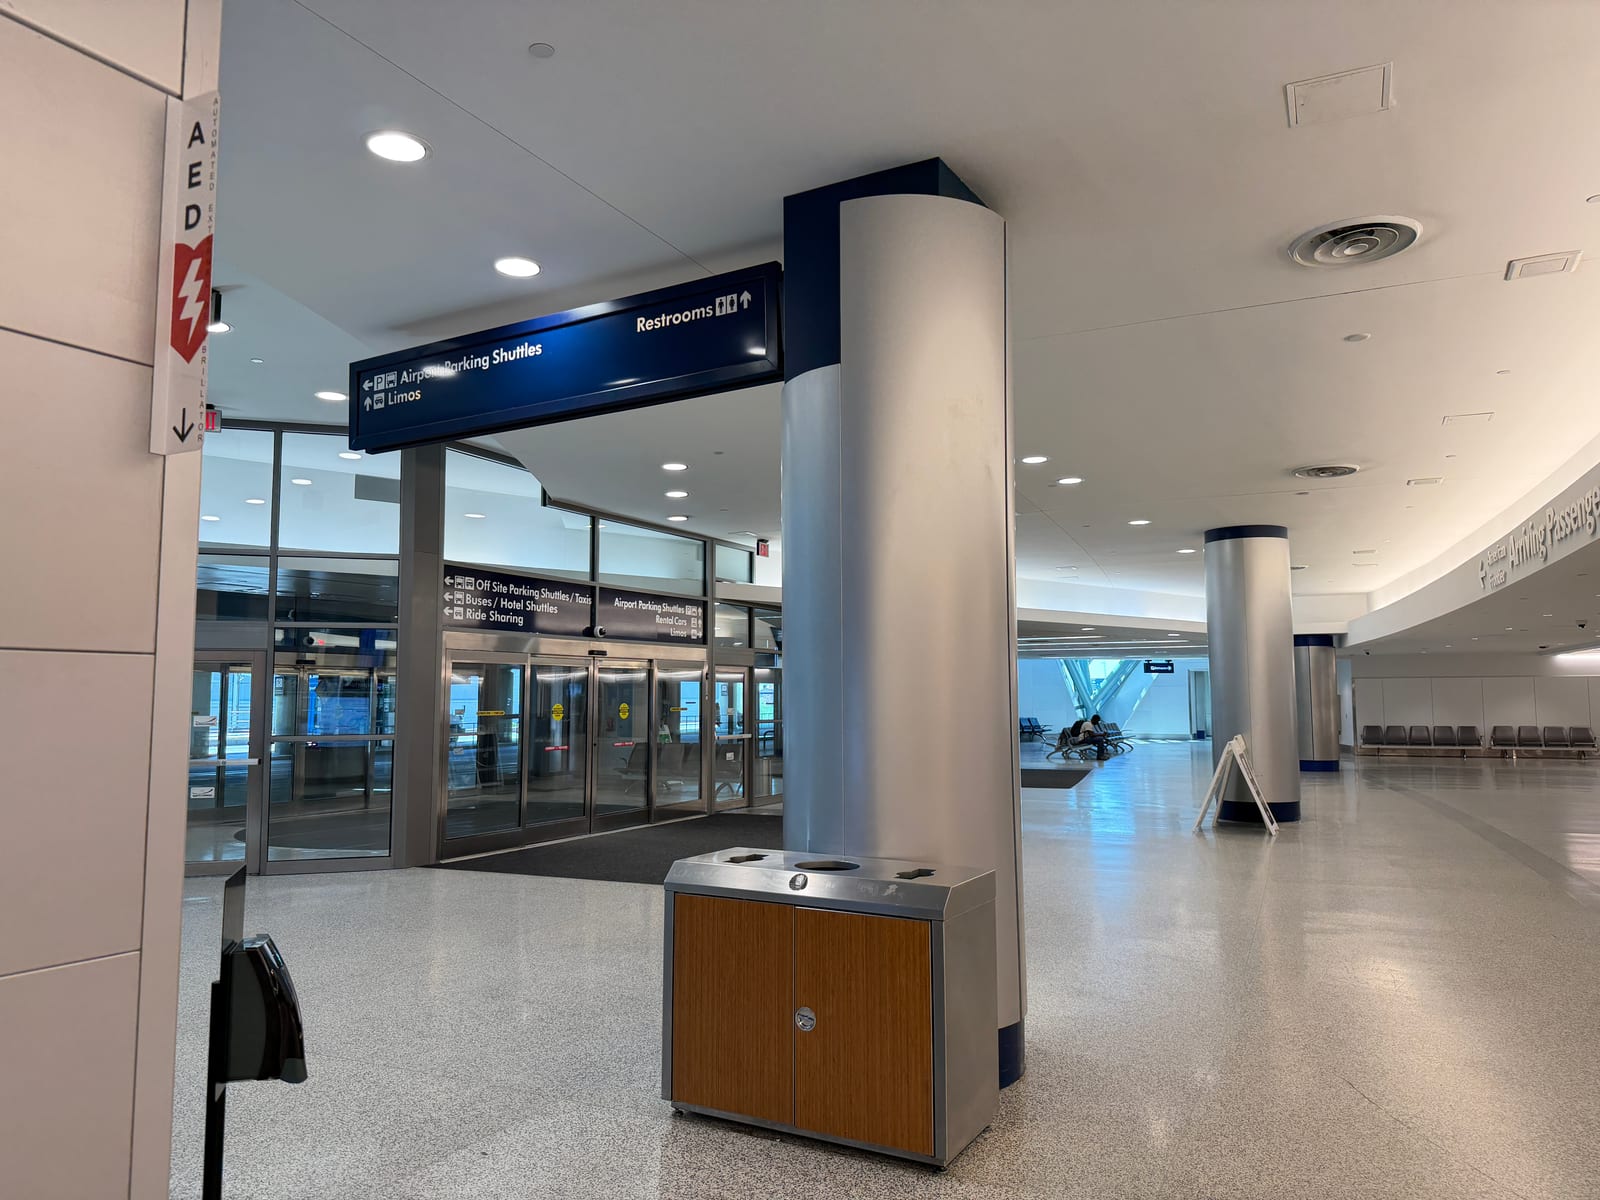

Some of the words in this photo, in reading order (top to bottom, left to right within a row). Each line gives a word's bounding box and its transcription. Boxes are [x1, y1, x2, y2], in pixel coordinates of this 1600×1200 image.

[209, 97, 218, 191] AUTOMATED
[185, 121, 205, 231] AED
[636, 304, 714, 333] Restrooms
[400, 364, 441, 385] Airport
[444, 353, 490, 373] Parking
[492, 342, 542, 365] Shuttles
[388, 389, 421, 406] Limos
[1508, 521, 1547, 568] Arriving
[466, 593, 492, 607] Buses
[500, 597, 523, 610] Hotel
[526, 600, 558, 614] Shuttles
[476, 580, 491, 591] Off
[492, 582, 508, 594] Site
[509, 584, 540, 600] Parking
[541, 588, 570, 602] Shuttles
[575, 593, 592, 605] Taxis
[466, 608, 487, 620] Ride
[489, 610, 524, 626] Sharing
[614, 597, 637, 610] Airport
[638, 601, 662, 614] Parking
[662, 603, 685, 614] Shuttles
[656, 615, 674, 625] Rental
[674, 617, 687, 626] Cars
[670, 628, 687, 637] Limos
